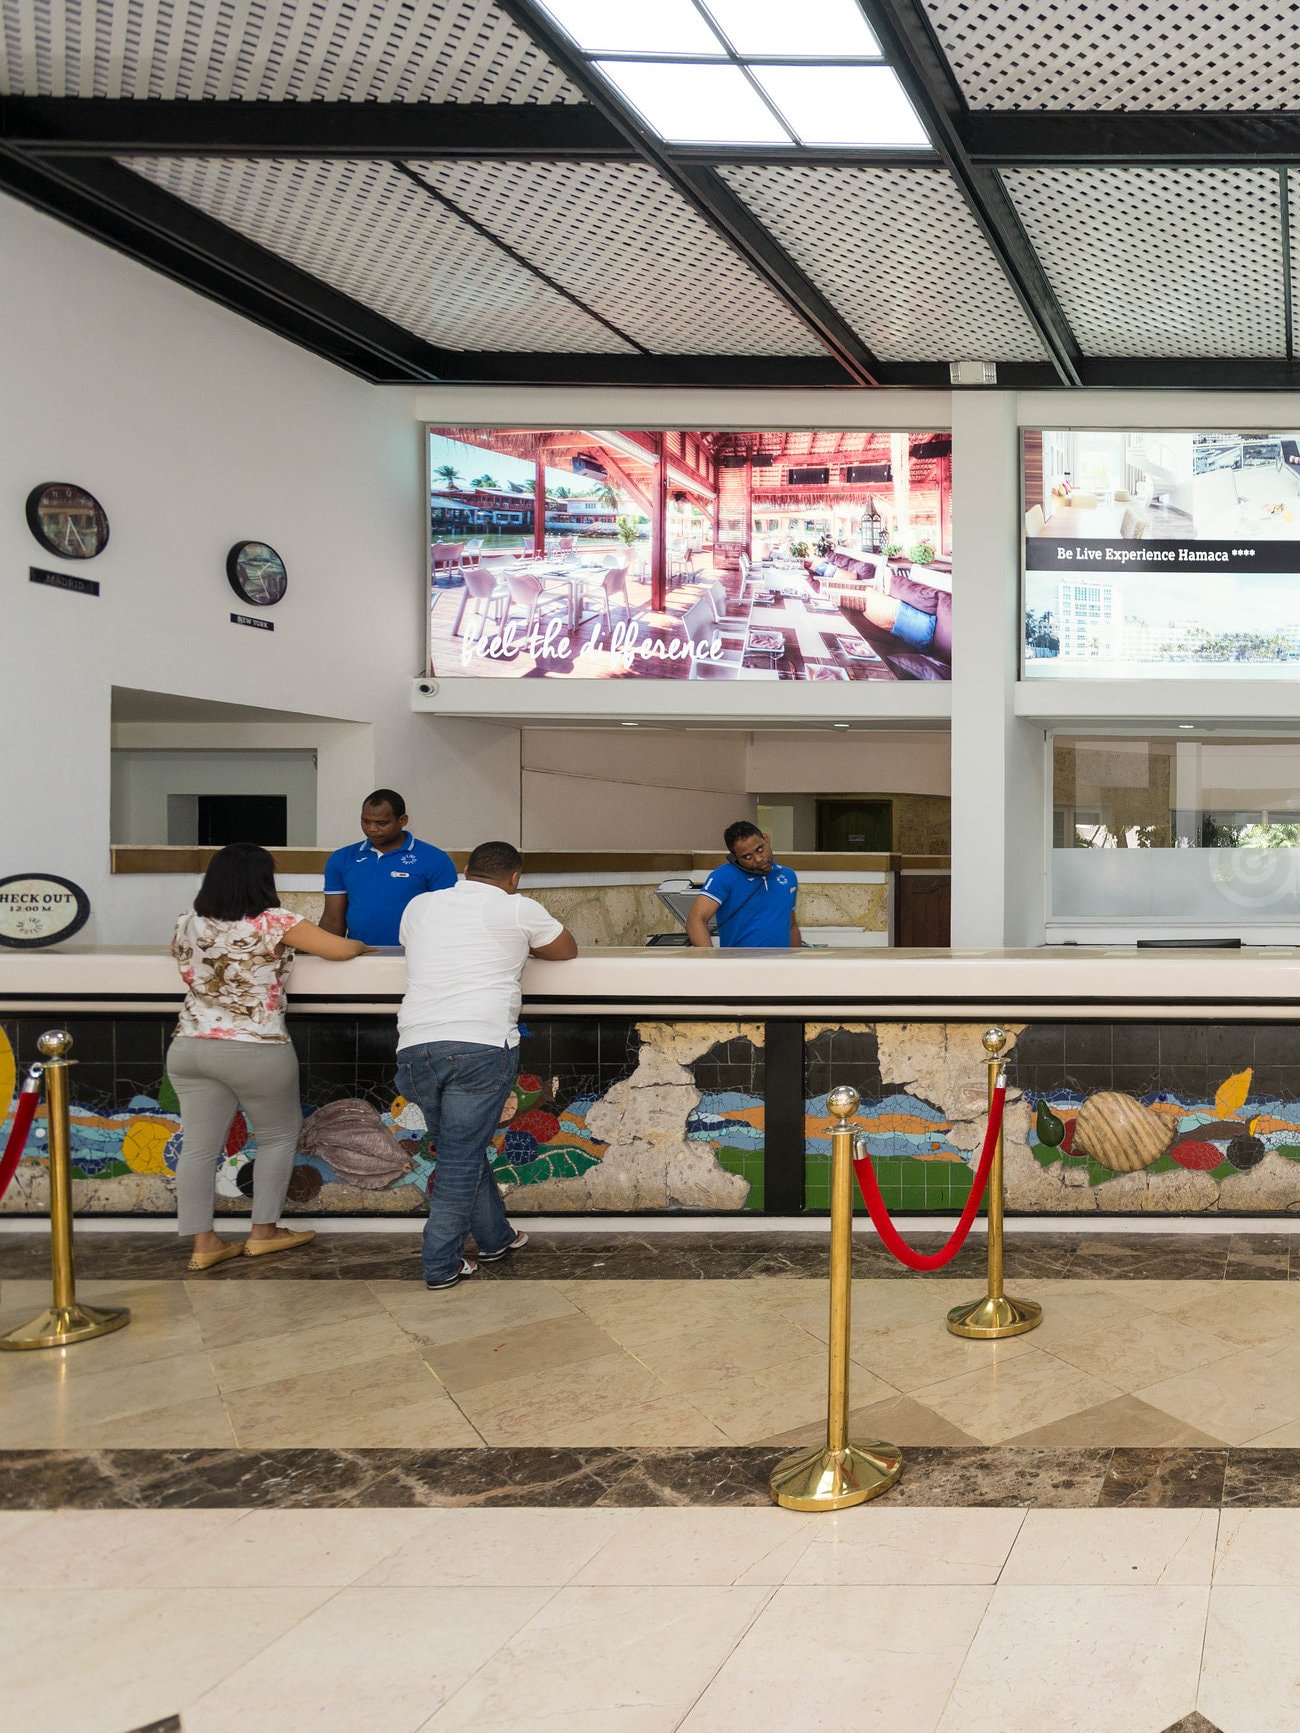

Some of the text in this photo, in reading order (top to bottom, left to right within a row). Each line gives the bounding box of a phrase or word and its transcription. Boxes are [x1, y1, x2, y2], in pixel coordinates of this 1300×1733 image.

[1057, 547, 1229, 564] Be Live Experience Hamaca
[237, 615, 252, 624] NEW
[461, 617, 725, 670] feel the difference
[0, 893, 73, 904] HECK OUT
